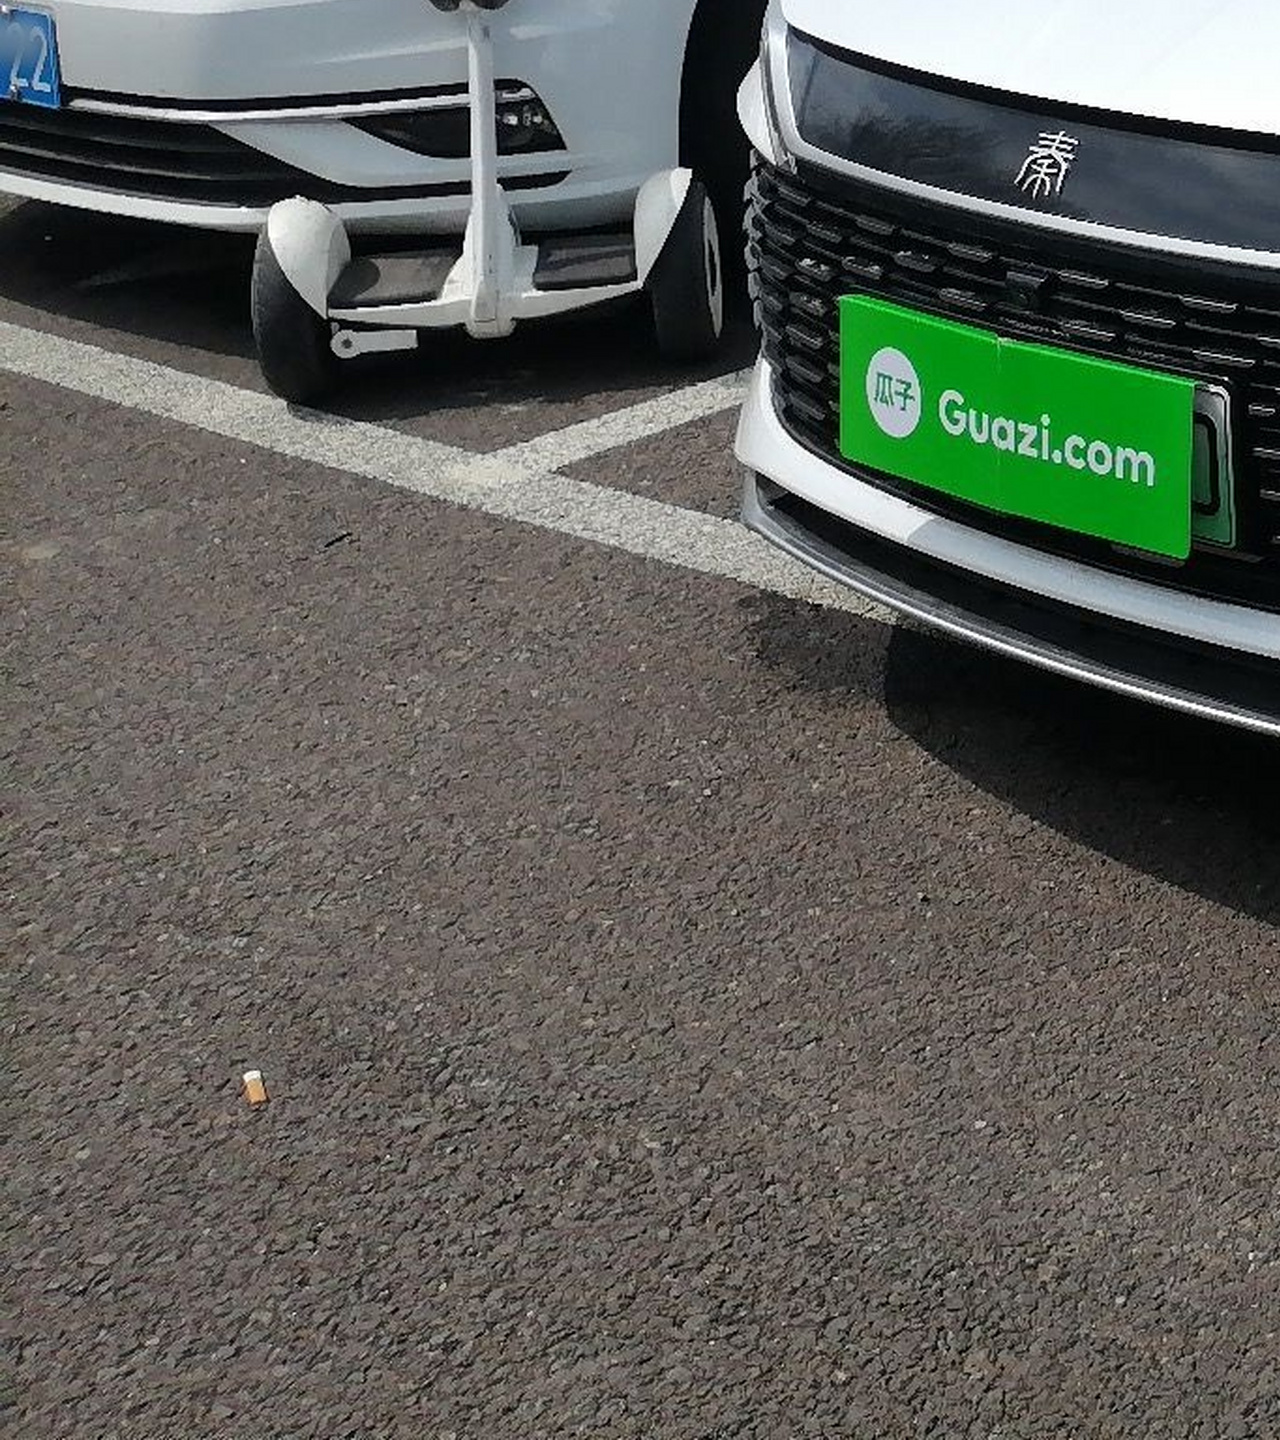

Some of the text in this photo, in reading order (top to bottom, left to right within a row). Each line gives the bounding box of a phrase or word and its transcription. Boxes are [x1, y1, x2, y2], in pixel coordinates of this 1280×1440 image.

[1014, 130, 1079, 199] 秦
[873, 371, 916, 412] 瓜子
[938, 389, 1156, 487] Guazi.com
